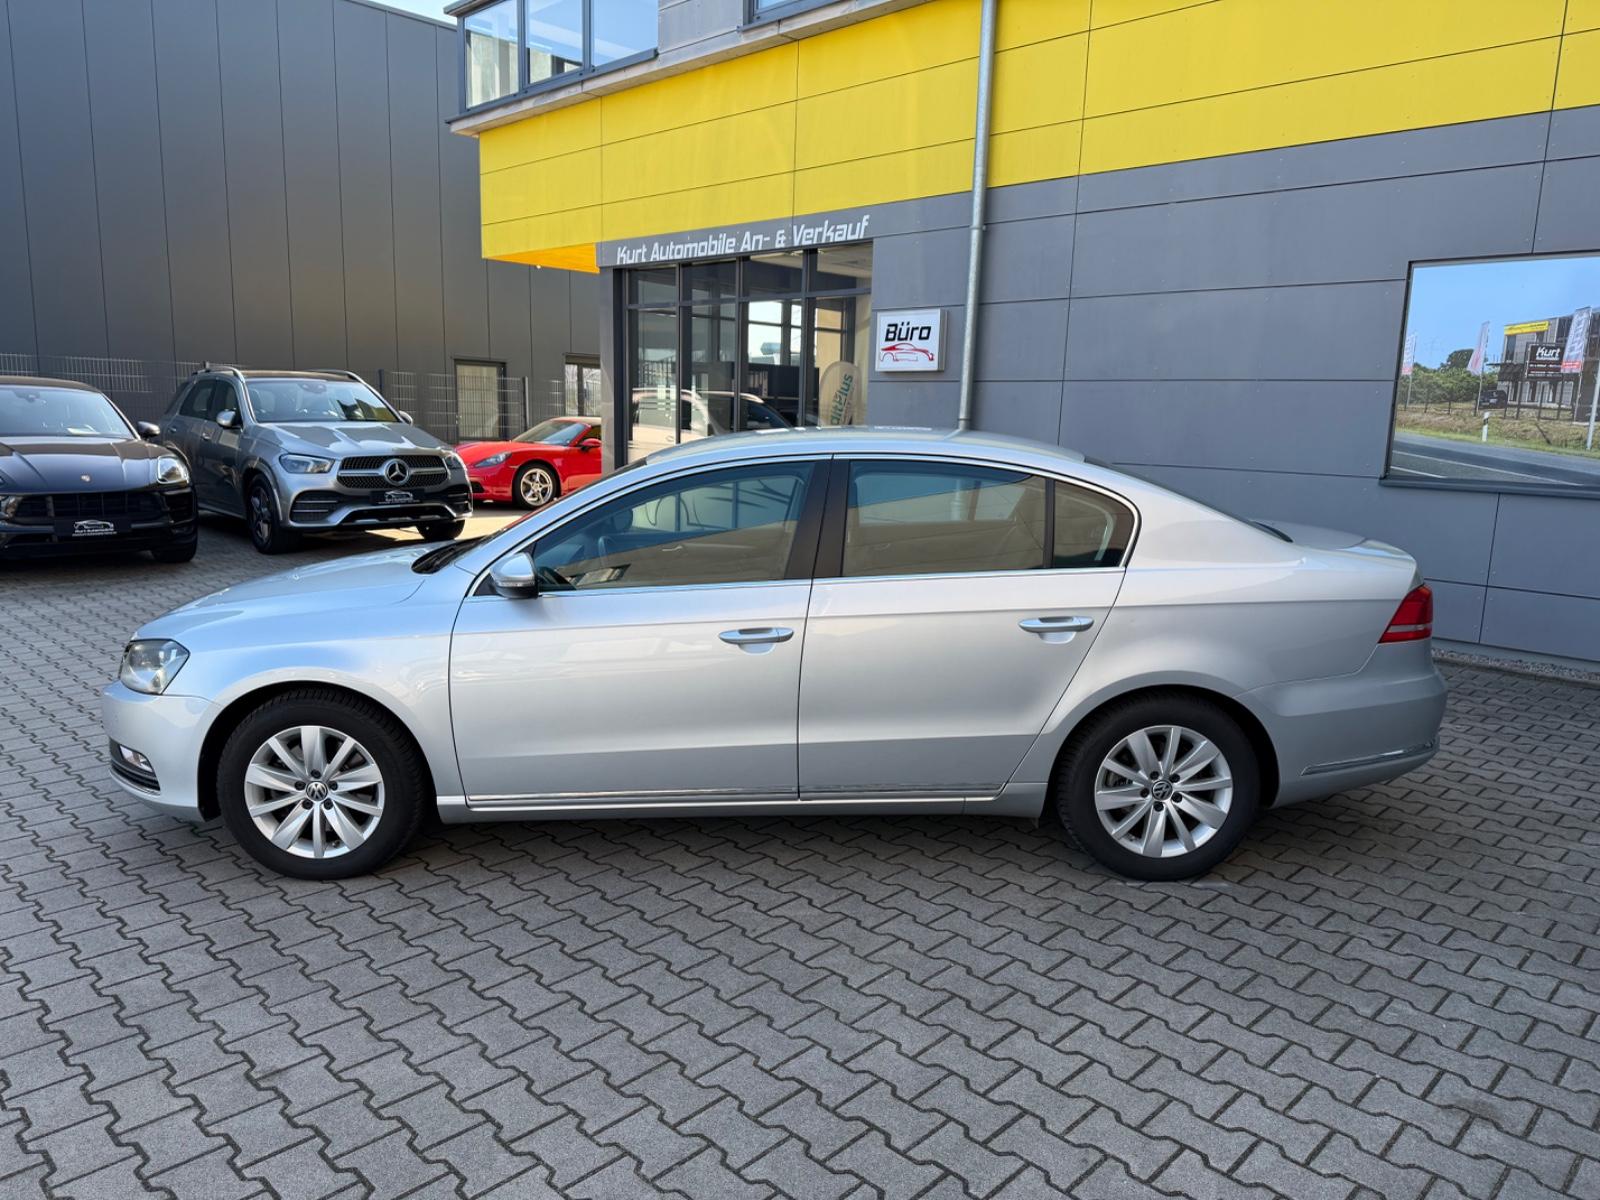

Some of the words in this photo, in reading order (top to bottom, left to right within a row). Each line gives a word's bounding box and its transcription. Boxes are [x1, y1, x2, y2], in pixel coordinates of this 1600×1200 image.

[617, 244, 647, 265] Kurt
[650, 233, 736, 262] Automobile
[740, 231, 770, 252] An-
[775, 229, 786, 248] &
[793, 215, 870, 246] Verkauf
[885, 321, 931, 342] Büro
[1536, 347, 1560, 357] Kurt
